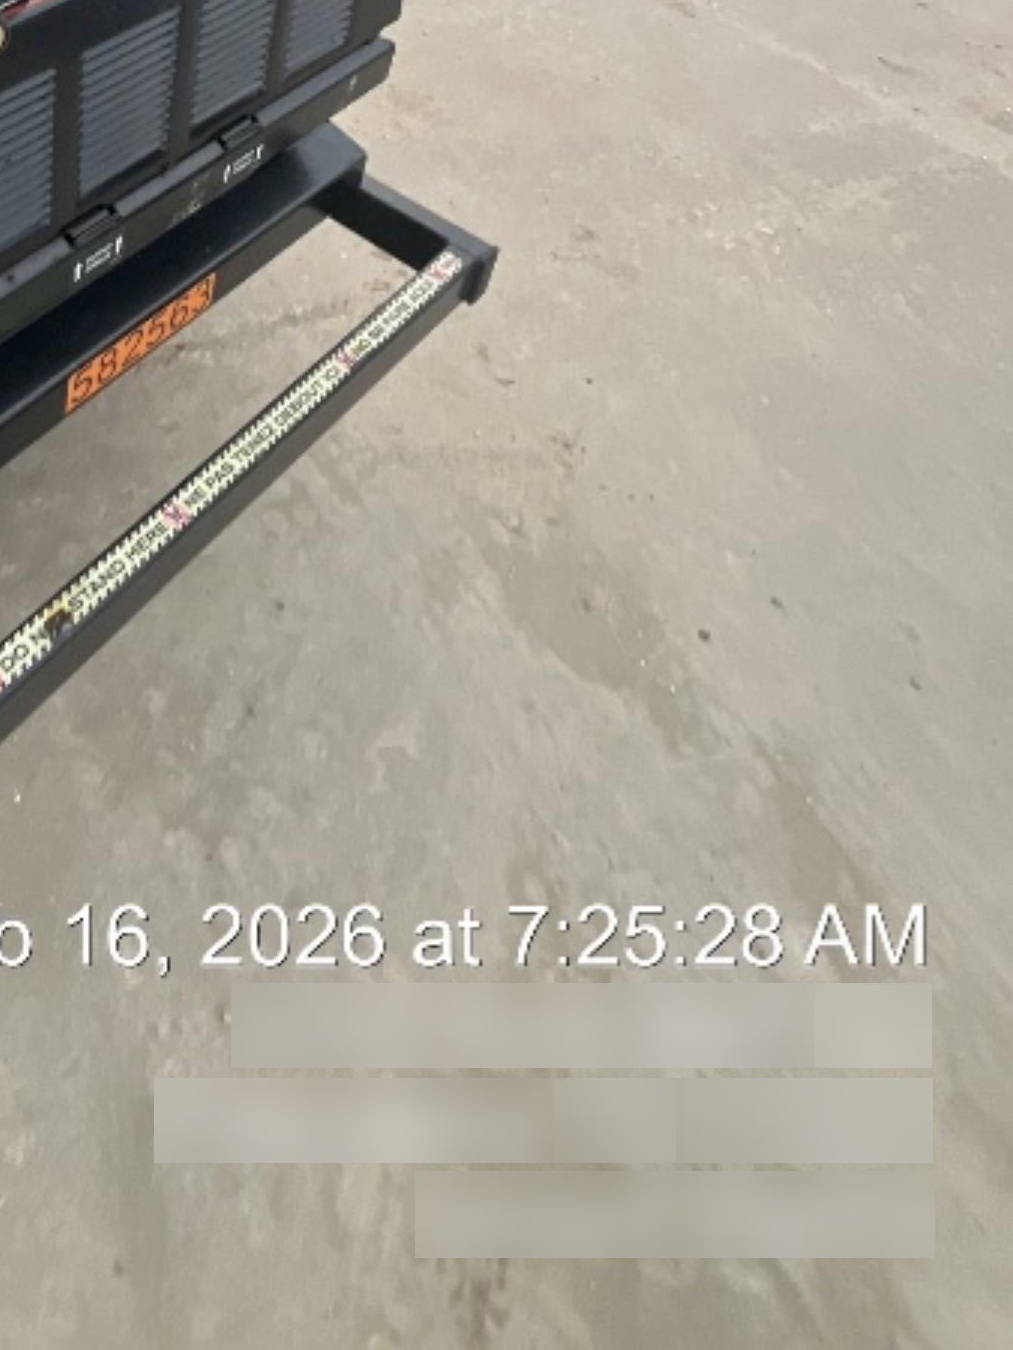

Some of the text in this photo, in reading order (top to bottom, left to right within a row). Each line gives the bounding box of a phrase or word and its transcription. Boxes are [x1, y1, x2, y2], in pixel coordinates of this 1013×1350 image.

[71, 279, 213, 403] 582563
[65, 555, 128, 613] STAND
[122, 519, 169, 563] HERE
